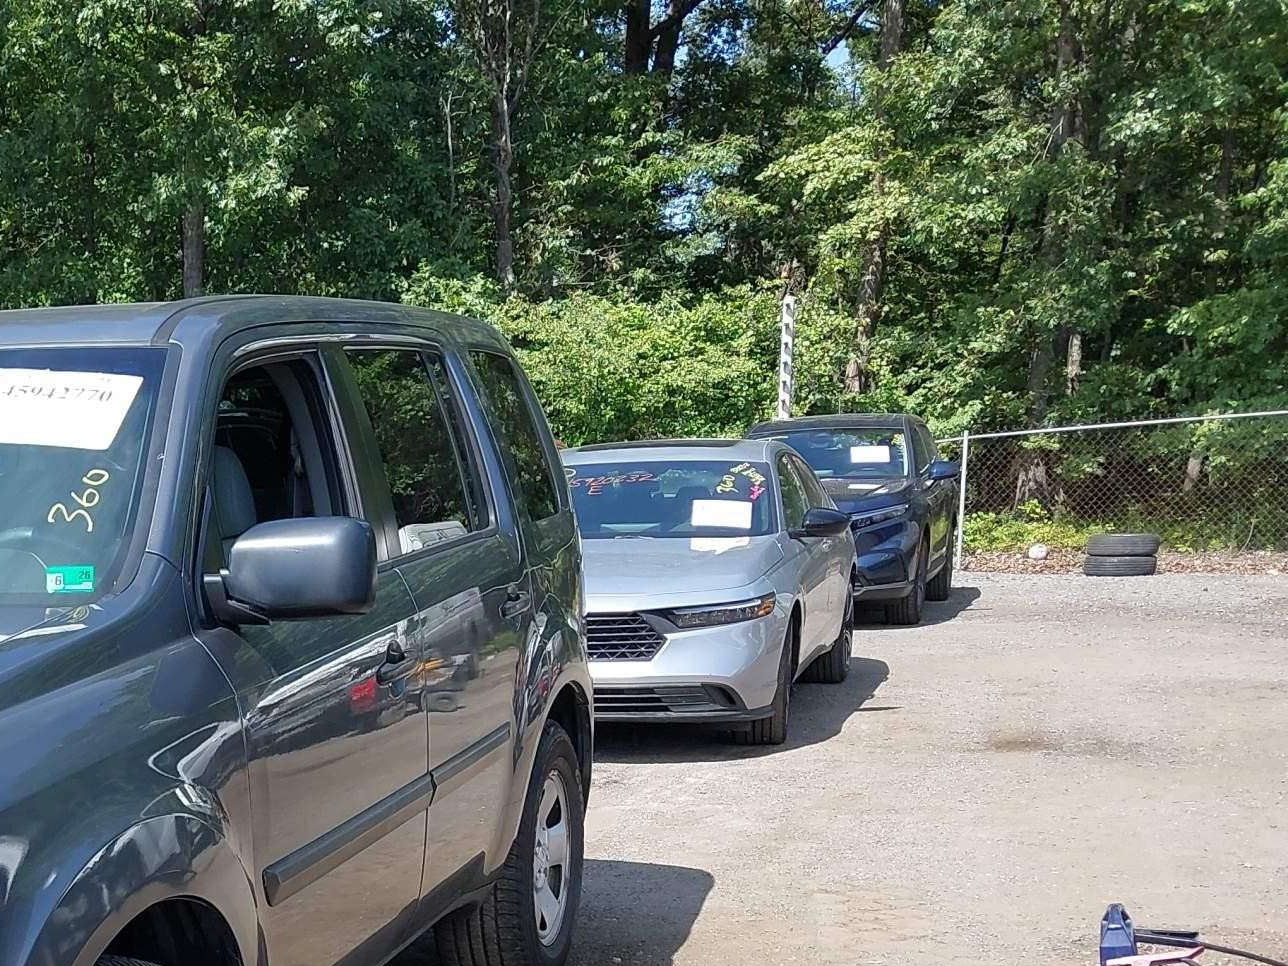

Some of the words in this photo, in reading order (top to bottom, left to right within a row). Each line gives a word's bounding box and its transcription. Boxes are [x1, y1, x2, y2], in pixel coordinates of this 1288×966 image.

[2, 385, 113, 402] 45942770
[47, 468, 110, 533] 360
[55, 575, 62, 586] 6
[78, 570, 91, 580] 26
